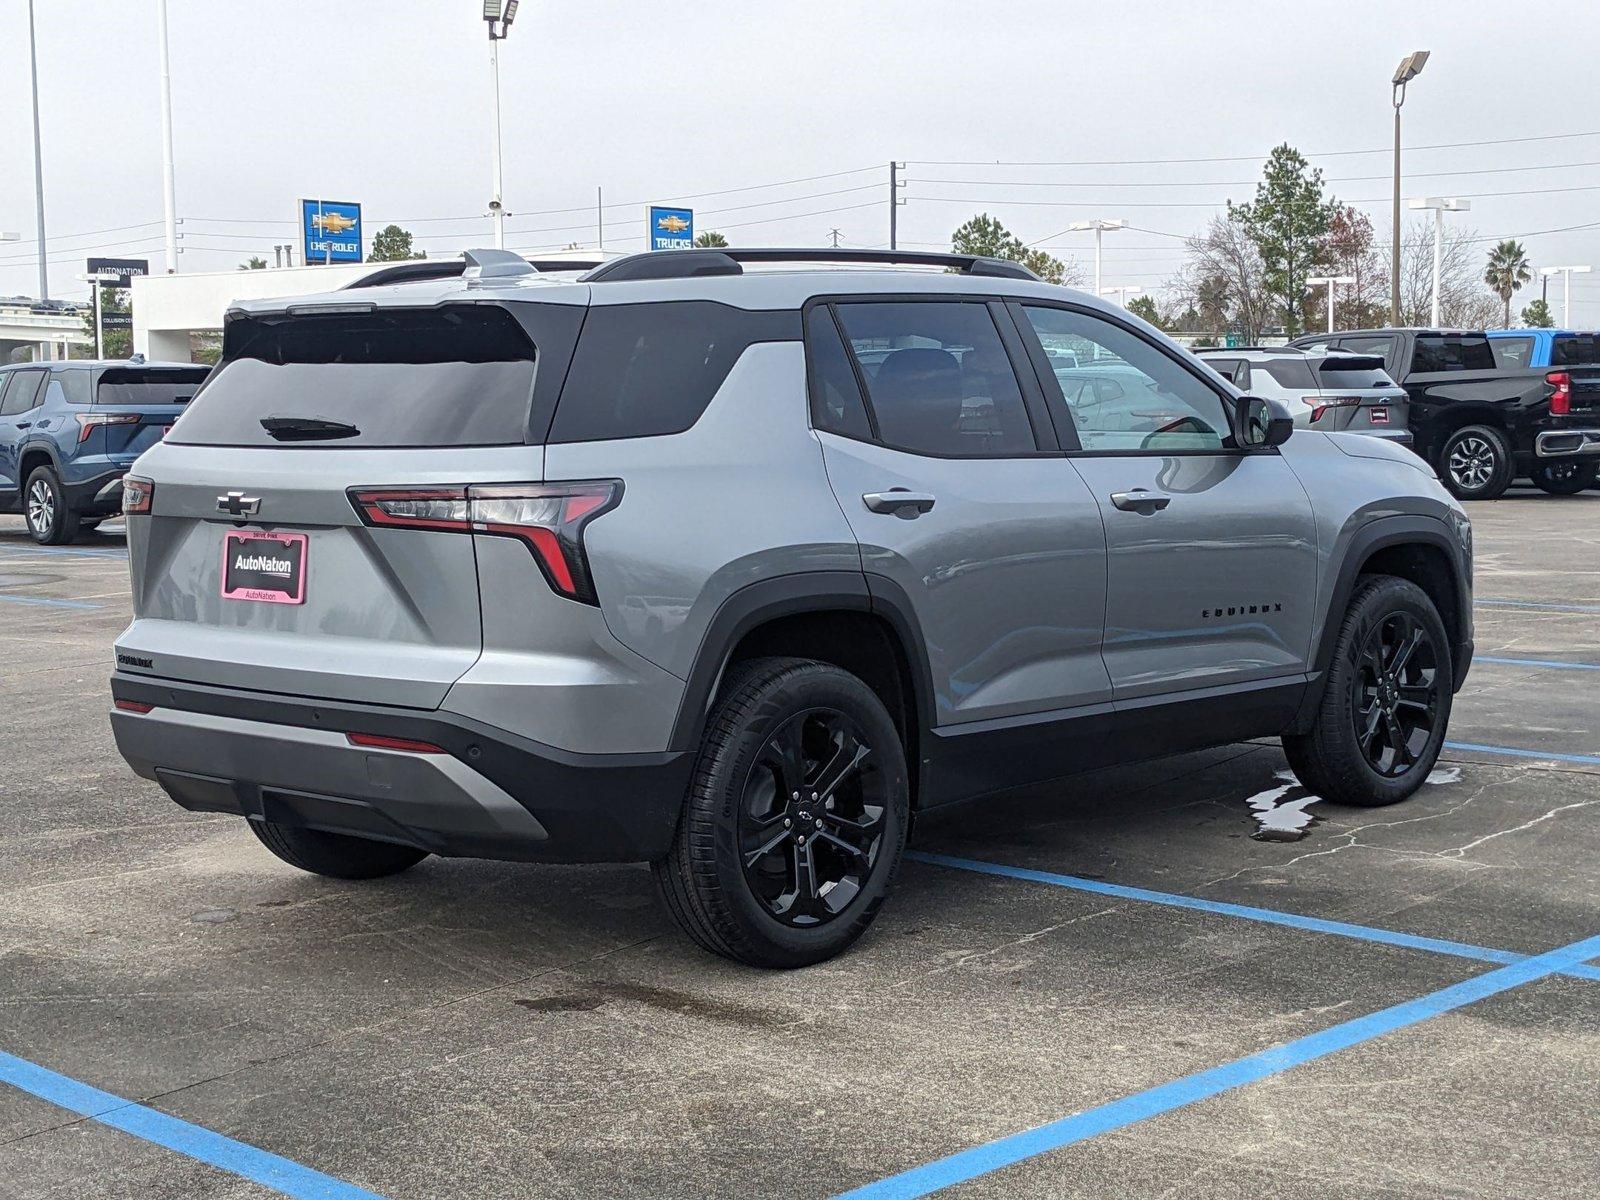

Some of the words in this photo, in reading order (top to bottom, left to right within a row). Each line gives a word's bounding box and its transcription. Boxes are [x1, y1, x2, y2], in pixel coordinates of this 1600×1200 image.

[310, 242, 358, 252] CHEROLET
[656, 238, 691, 249] TRUCKS
[97, 267, 144, 276] AUTONATION
[235, 554, 291, 573] AutoNation
[245, 590, 276, 600] AutoNation
[1202, 603, 1282, 618] EQUINOX
